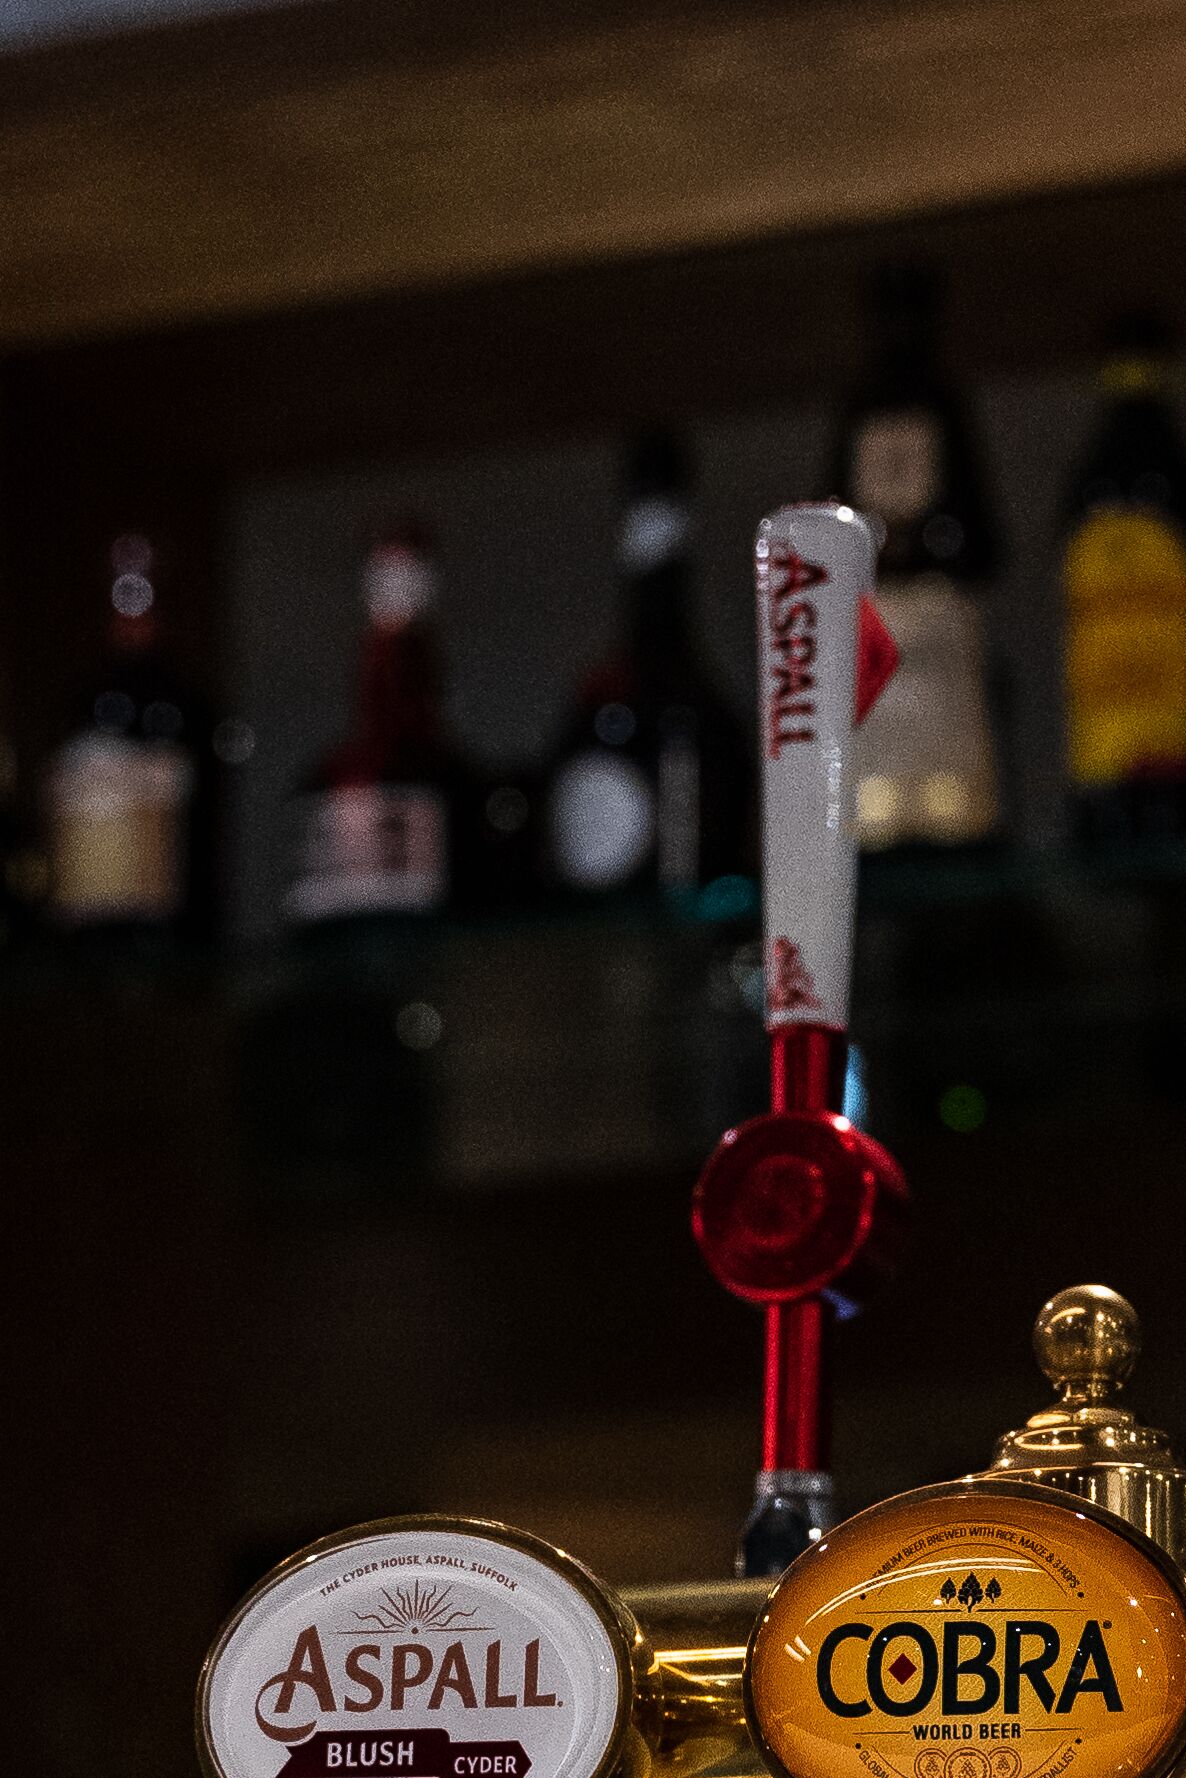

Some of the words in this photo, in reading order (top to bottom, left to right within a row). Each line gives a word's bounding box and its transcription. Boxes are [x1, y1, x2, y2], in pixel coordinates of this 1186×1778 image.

[768, 540, 828, 760] ASPALL
[903, 1540, 927, 1560] BEER
[926, 1528, 967, 1547] BREWED
[969, 1527, 994, 1538] WITH
[1018, 1534, 1048, 1559] MAIZE
[319, 1580, 341, 1598] THE
[342, 1563, 379, 1583] CYDER
[426, 1555, 467, 1571] ASPALL,
[470, 1562, 519, 1592] SUFFOLK
[255, 1624, 558, 1742] ASPALL
[816, 1620, 1125, 1718] COBRA
[912, 1724, 973, 1741] WORLD
[979, 1723, 1022, 1739] BEER
[326, 1741, 414, 1767] BLUSH
[454, 1756, 517, 1775] CYDER
